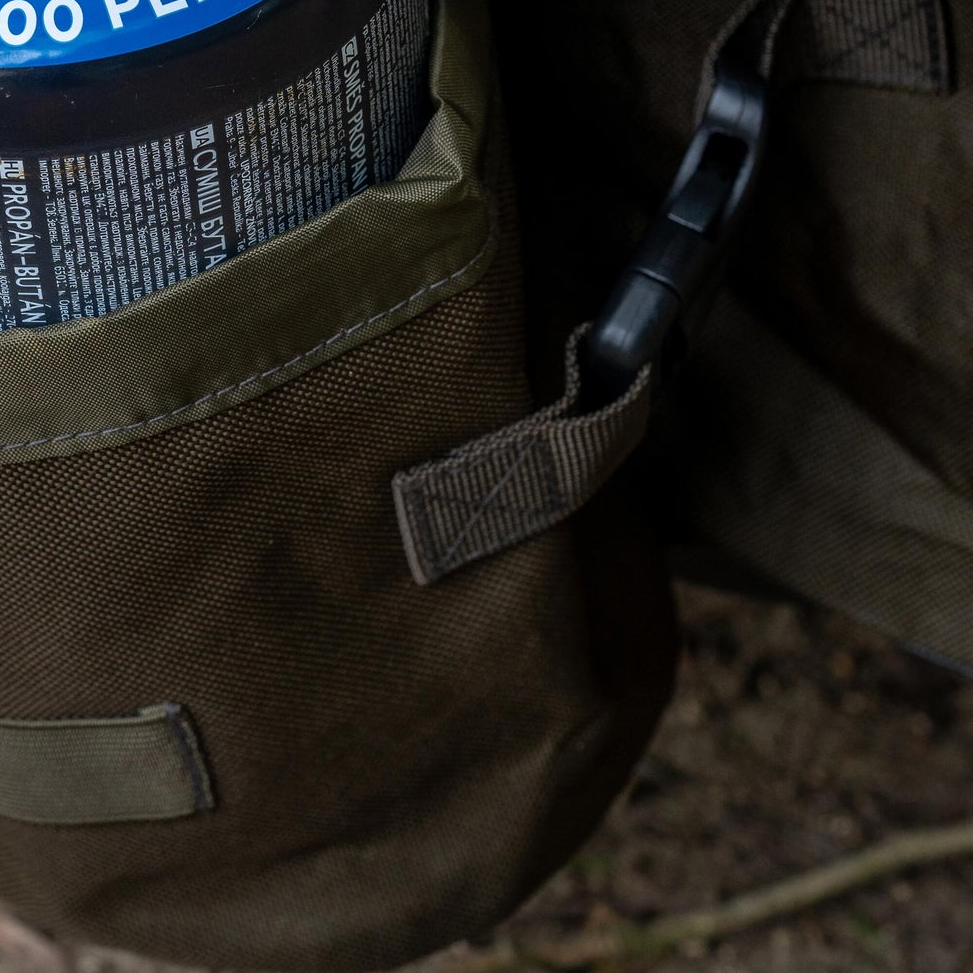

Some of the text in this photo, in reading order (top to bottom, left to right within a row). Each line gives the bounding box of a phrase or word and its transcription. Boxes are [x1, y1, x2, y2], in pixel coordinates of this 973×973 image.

[343, 60, 366, 112] SMĚS
[194, 125, 210, 147] UA
[347, 109, 369, 190] PROPAN
[4, 161, 21, 179] HU
[193, 149, 224, 215] СУМІШ
